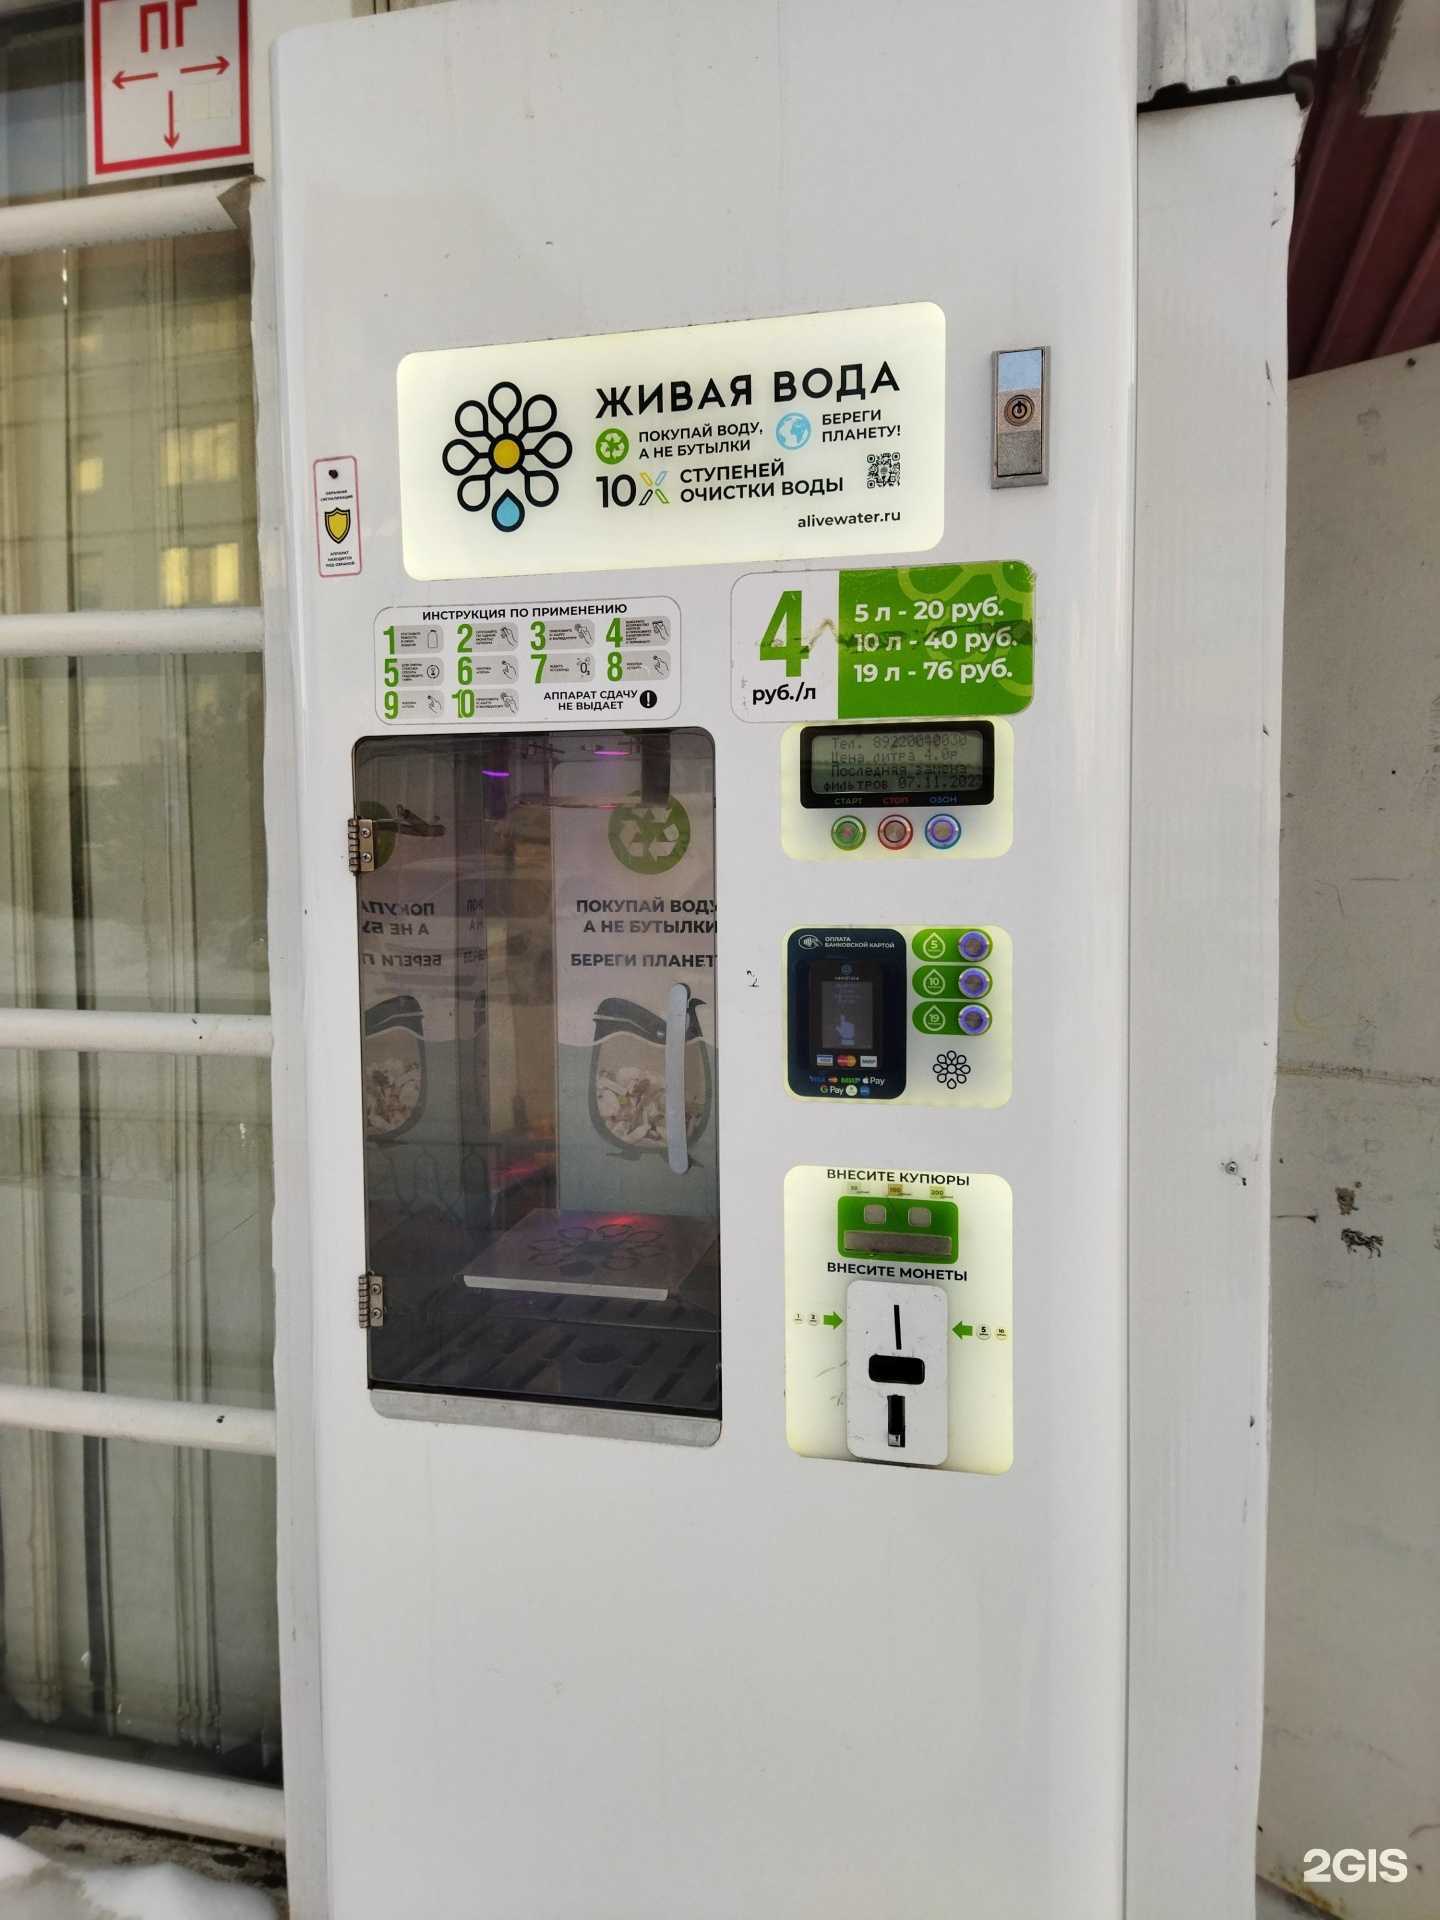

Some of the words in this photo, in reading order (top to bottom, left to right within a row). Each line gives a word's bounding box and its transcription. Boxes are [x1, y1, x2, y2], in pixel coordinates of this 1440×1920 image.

[140, 0, 197, 52] ПГ
[595, 375, 752, 419] ЖИВАЯ
[774, 361, 900, 403] ВОДА
[822, 410, 881, 426] БЕРЕГИ
[639, 423, 713, 443] ПОКУПАЙ
[718, 422, 763, 439] ВОДУ,
[822, 424, 901, 443] ПЛАНЕТУ!
[639, 446, 649, 459] А
[653, 444, 672, 458] НЕ
[675, 439, 751, 457] БУТЫЛКИ
[680, 460, 785, 482] СТУПЕНЕЙ
[680, 482, 776, 503] ОЧИСТКИ
[781, 477, 843, 496] ВОДЫ
[797, 510, 901, 529] alivewater.ru
[422, 608, 506, 621] ИНСТРУКЦИЯ
[510, 607, 529, 618] ПО
[532, 604, 627, 617] ПРИМЕНЕНИЮ
[855, 604, 869, 621] 5
[874, 606, 891, 621] л
[913, 600, 944, 620] 20
[952, 596, 1005, 622] руб.
[384, 626, 395, 655] 1
[457, 624, 473, 653] 2
[530, 621, 546, 650] 3
[606, 618, 623, 648] 4
[759, 590, 810, 677] 4
[855, 634, 879, 652] 10
[885, 636, 902, 651] л
[924, 631, 958, 649] 40
[964, 627, 1018, 652] руб.
[384, 658, 399, 687] 5
[458, 656, 473, 685] 6
[530, 654, 547, 684] 7
[608, 651, 623, 682] 8
[854, 665, 878, 682] 19
[884, 666, 900, 681] л
[923, 662, 953, 680] 76
[960, 658, 1013, 683] руб.
[384, 691, 399, 719] 9
[451, 689, 475, 718] 10
[544, 691, 597, 701] АППАРАТ
[600, 690, 638, 700] СДАЧУ
[752, 682, 816, 705] руб./л
[558, 701, 575, 710] НЕ
[577, 701, 624, 710] ВЫДАЕТ
[832, 752, 864, 763] Цена
[576, 897, 664, 912] ПОКУПАЙ
[584, 921, 595, 933] А
[601, 921, 624, 933] НЕ
[630, 921, 717, 933] БУТЫЛКИ
[571, 954, 637, 966] БЕРЕГИ
[830, 1086, 844, 1096] Pay
[870, 1076, 885, 1085] Pay
[827, 1169, 894, 1182] ВНЕСИТЕ
[900, 1171, 970, 1186] КУПЮРЫ
[827, 1262, 895, 1277] ВНЕСИТЕ
[900, 1267, 967, 1281] МОНЕТЫ
